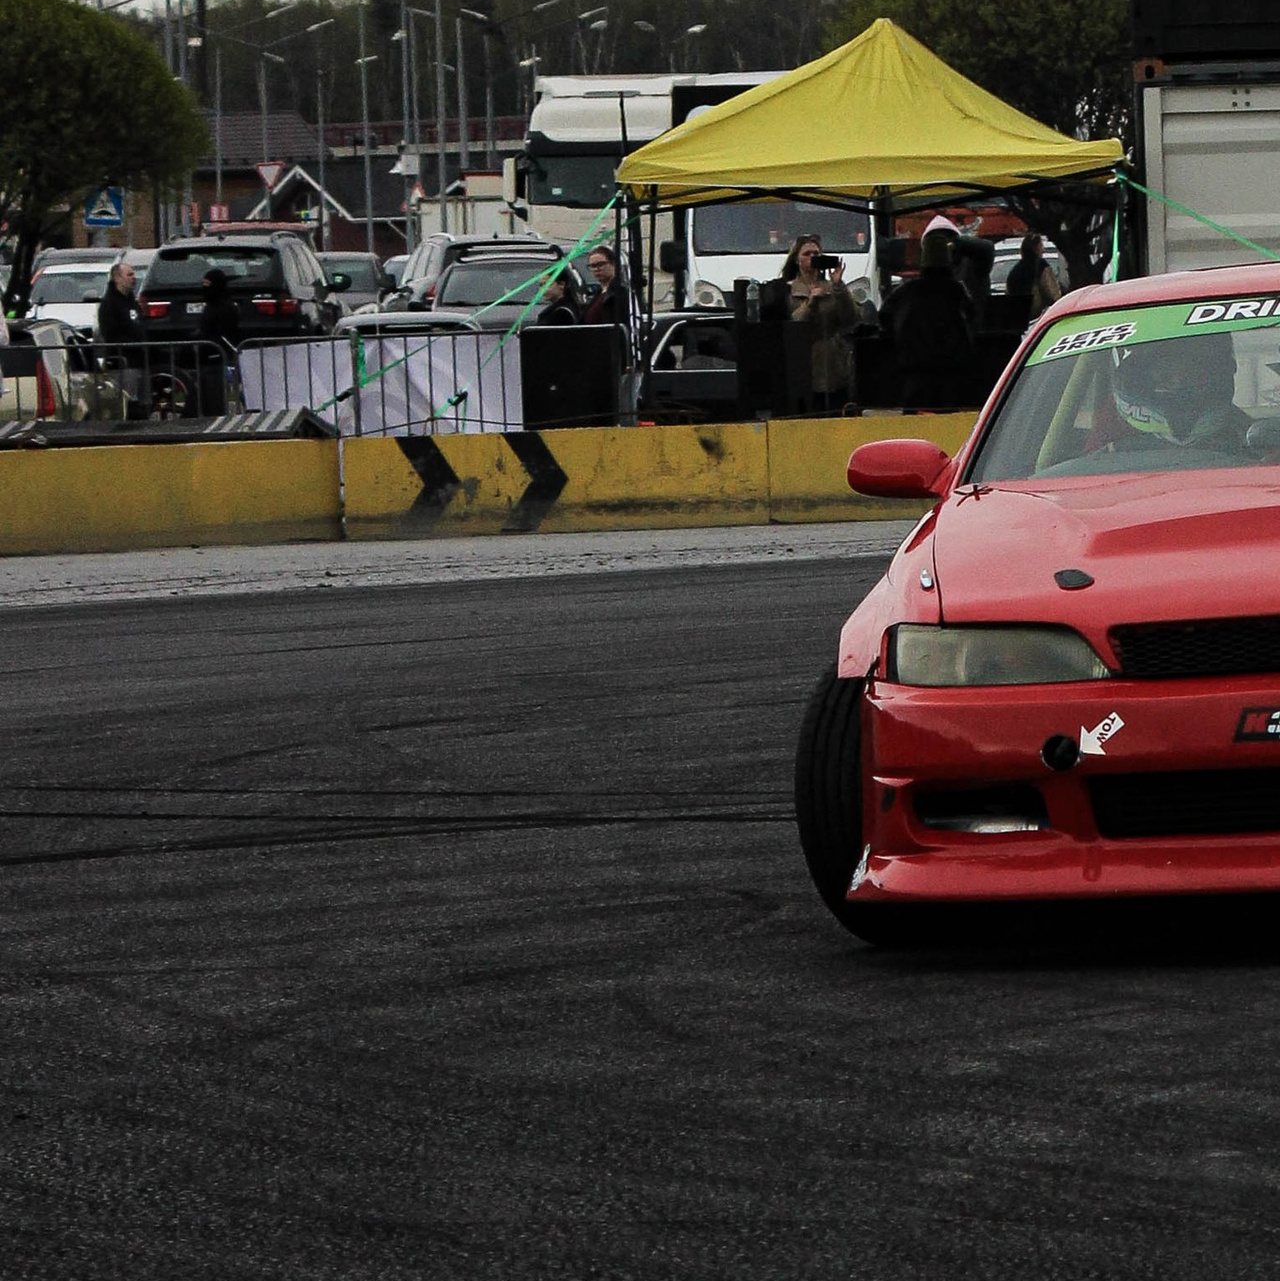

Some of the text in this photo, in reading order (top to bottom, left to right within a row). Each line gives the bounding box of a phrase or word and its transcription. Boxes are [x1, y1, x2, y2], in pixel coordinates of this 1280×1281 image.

[1046, 331, 1133, 356] DRIFT
[1057, 323, 1133, 346] LET'S
[1096, 716, 1117, 743] TOW
